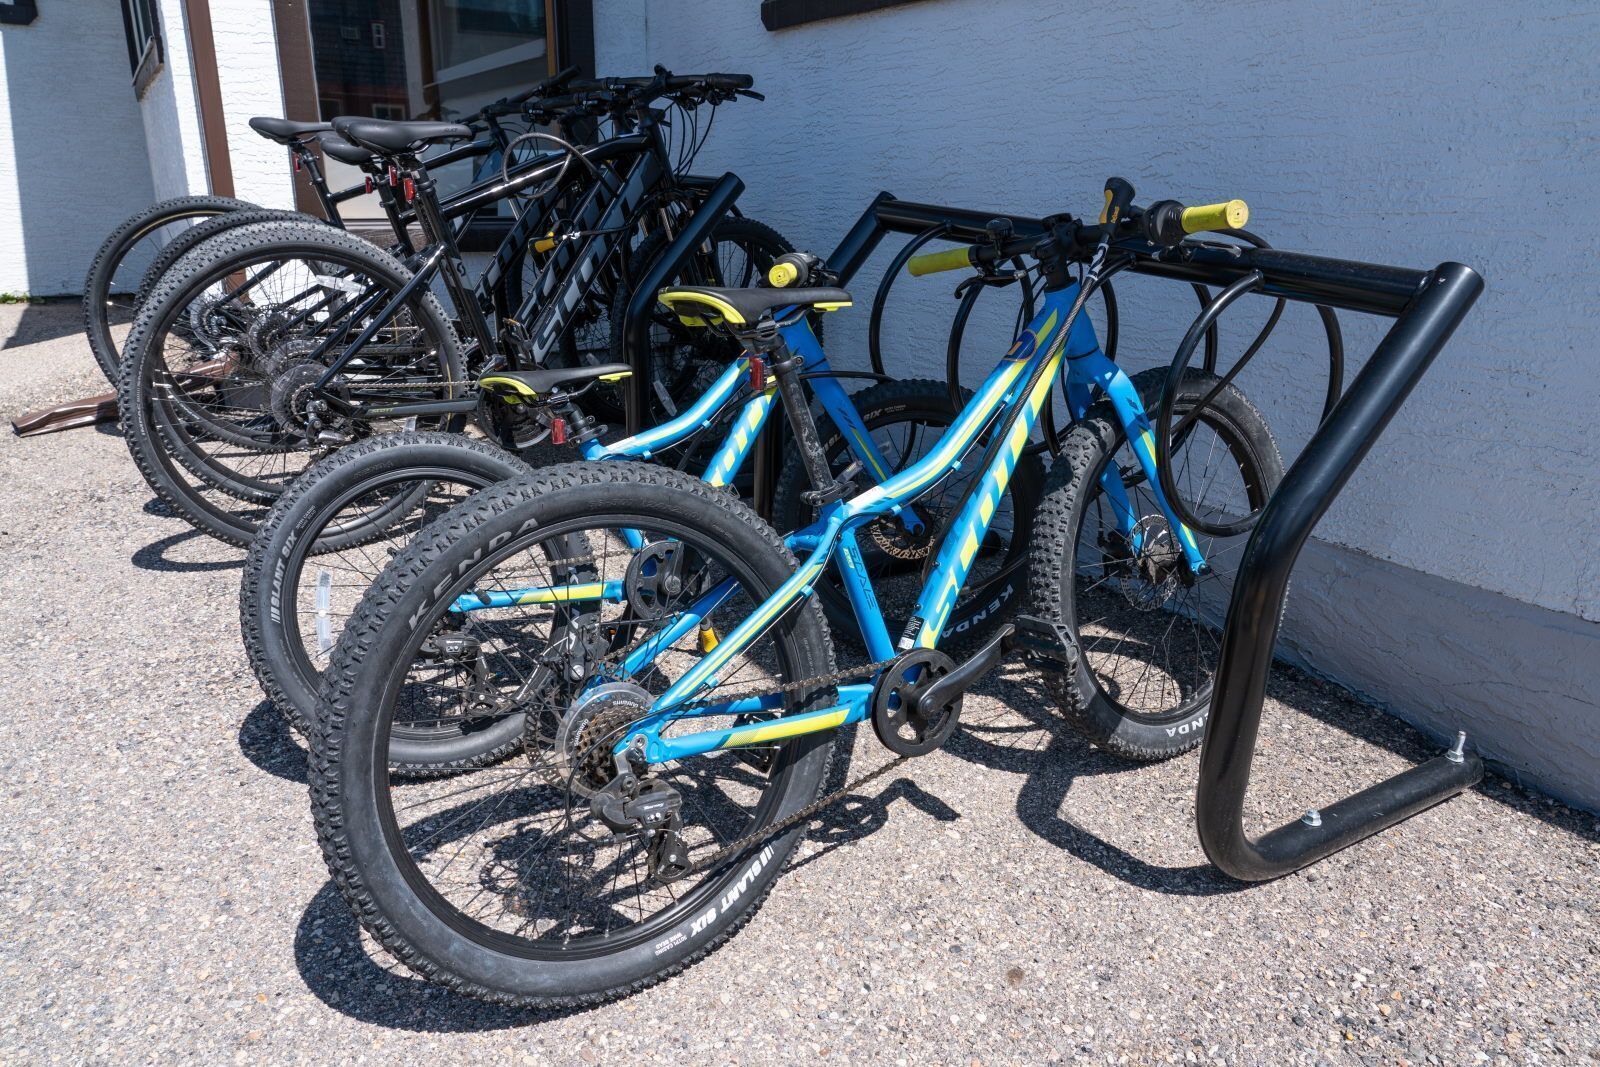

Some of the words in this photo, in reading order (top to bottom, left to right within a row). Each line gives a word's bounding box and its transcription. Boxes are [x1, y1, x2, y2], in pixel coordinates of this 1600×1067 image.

[271, 557, 286, 608] SLANT
[282, 529, 297, 558] SIX
[408, 517, 540, 631] KENDA
[848, 545, 878, 610] SCALE
[941, 583, 1014, 639] KENDA
[1165, 712, 1209, 738] NDA
[721, 859, 763, 914] SLANT
[690, 907, 717, 938] SIX
